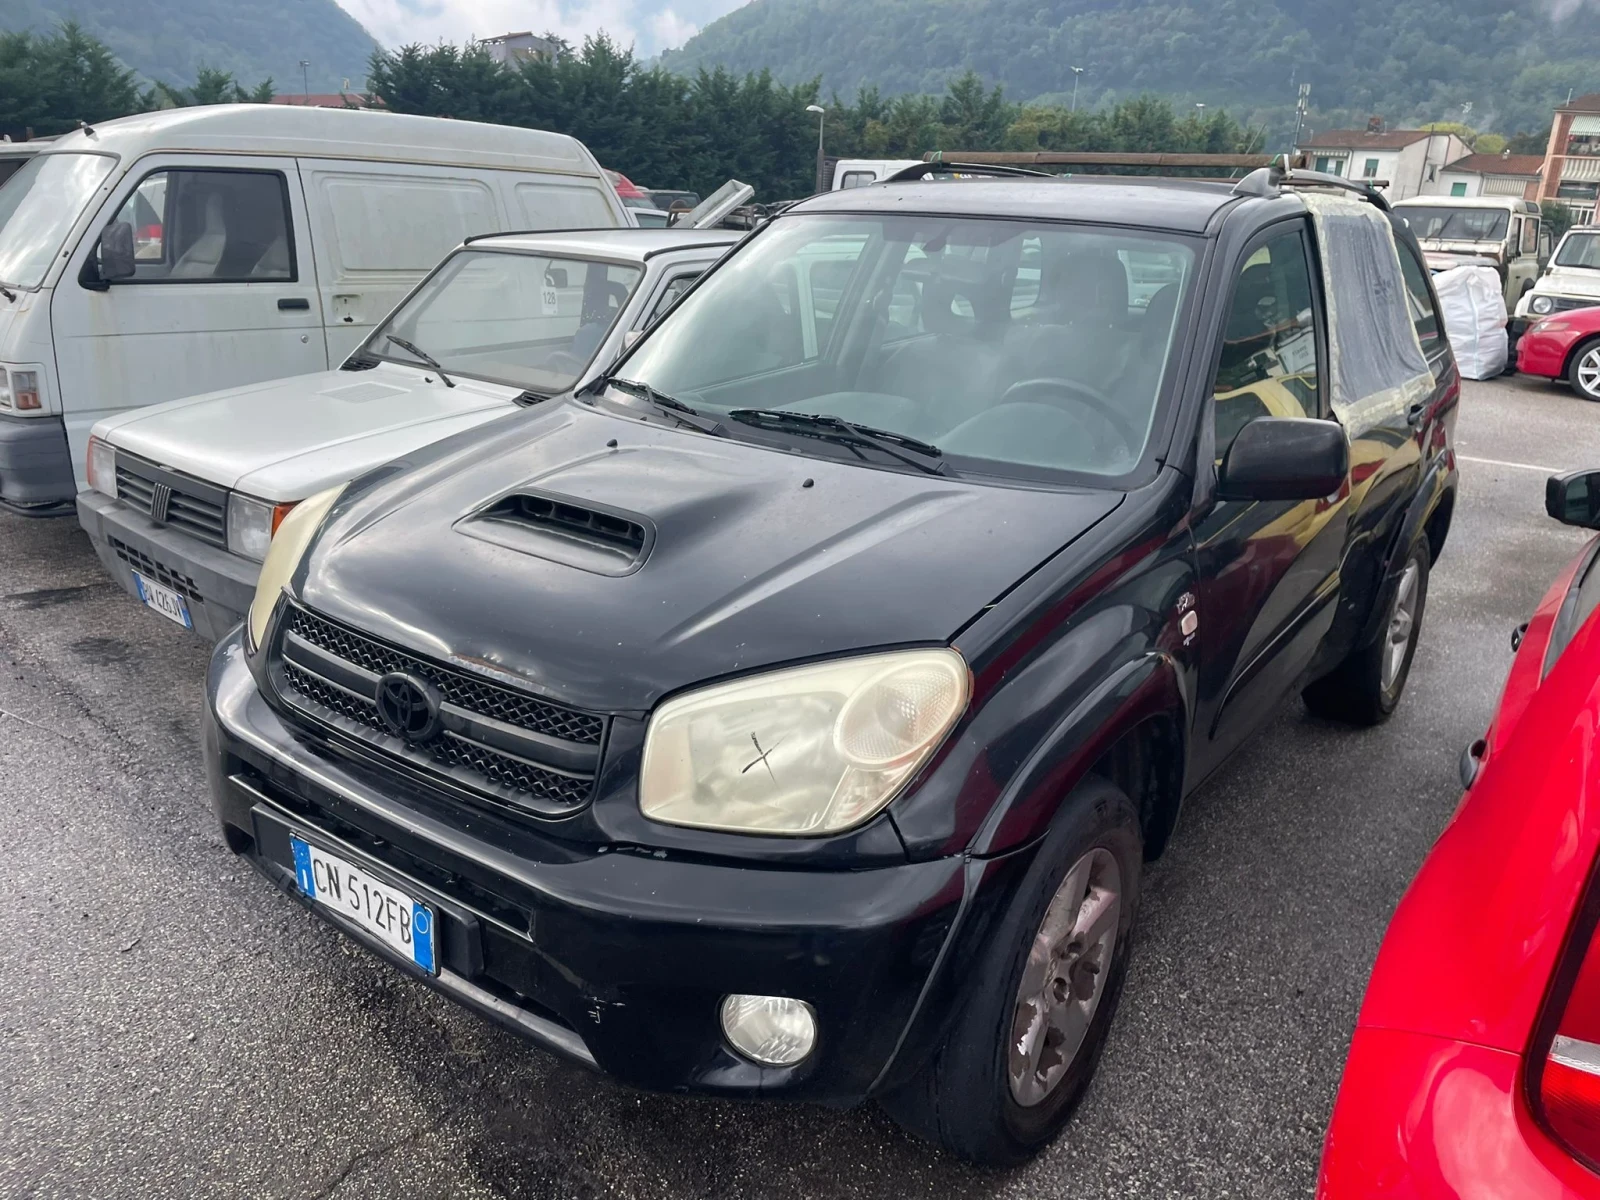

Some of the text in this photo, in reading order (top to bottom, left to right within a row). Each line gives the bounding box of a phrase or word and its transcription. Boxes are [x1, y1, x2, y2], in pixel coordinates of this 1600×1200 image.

[543, 291, 556, 304] 128
[313, 858, 412, 944] CN 512FB
